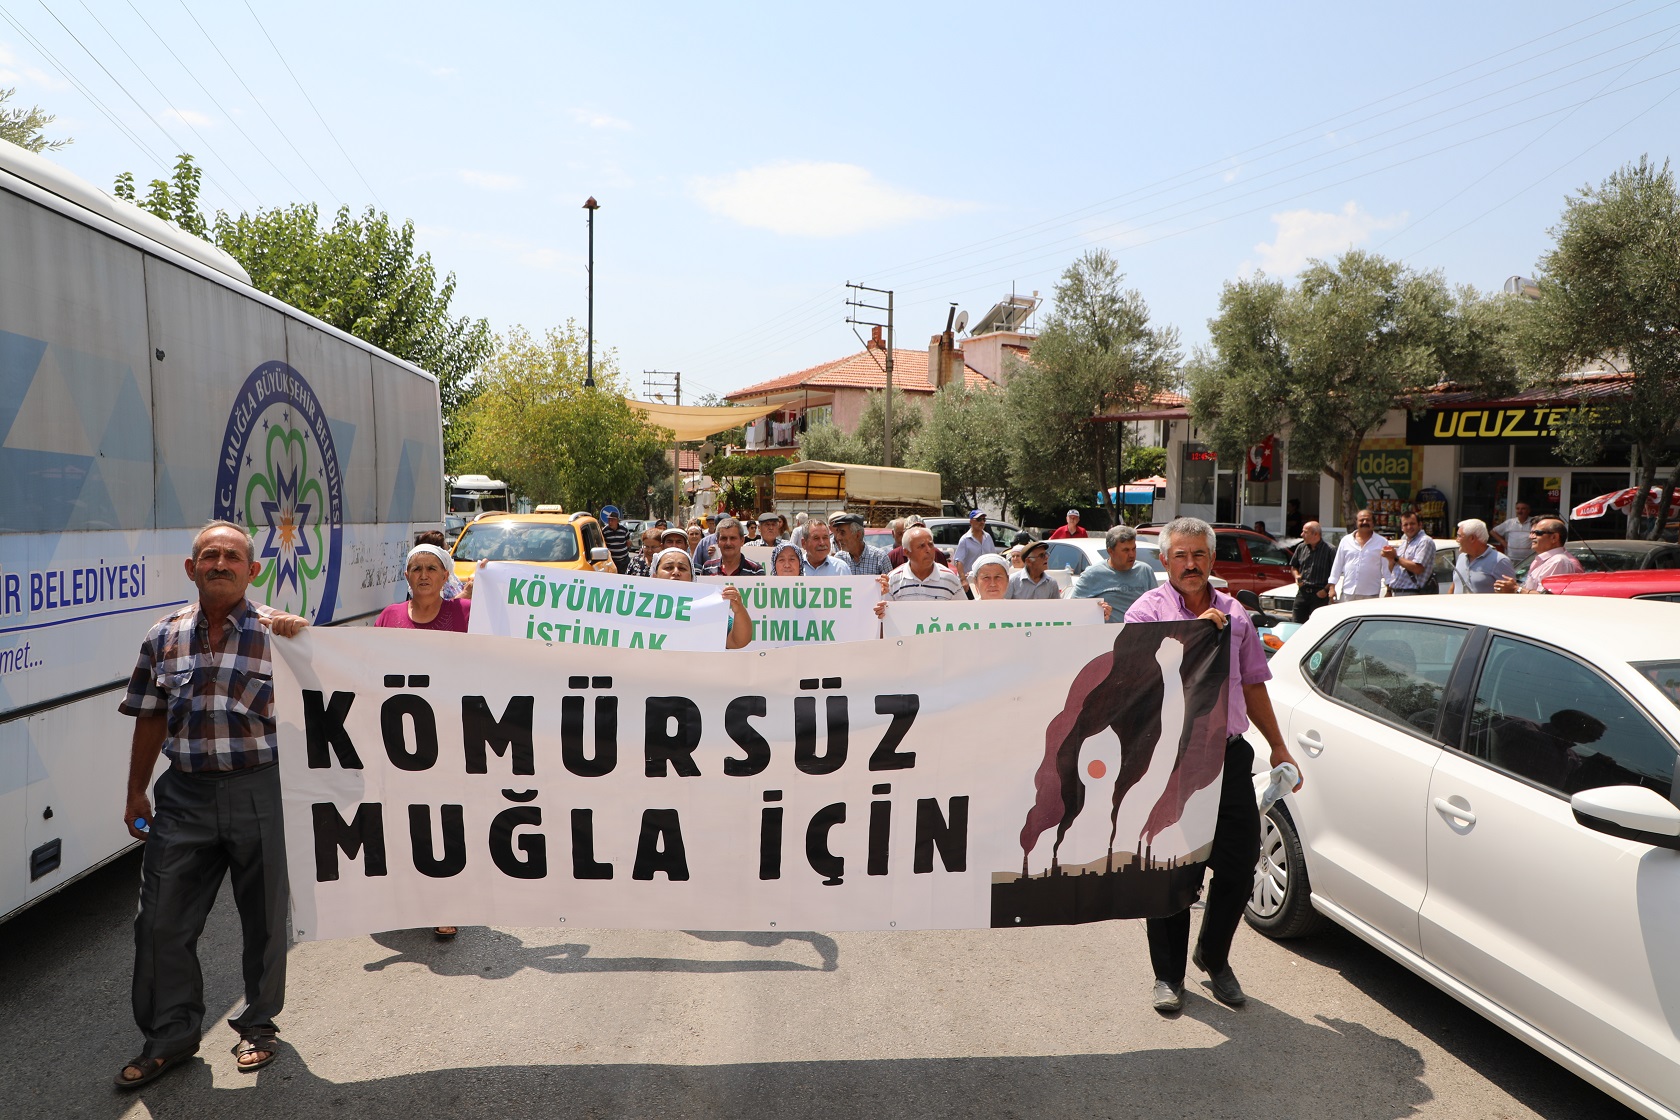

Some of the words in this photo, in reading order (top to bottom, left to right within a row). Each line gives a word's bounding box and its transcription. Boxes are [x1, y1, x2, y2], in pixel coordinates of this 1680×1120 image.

[225, 391, 258, 475] MUĞLA
[255, 367, 317, 421] BÜYÜKŞEHİR
[1433, 409, 1539, 438] UCUZ
[1356, 453, 1410, 474] iddaa
[1547, 489, 1560, 497] +18
[30, 555, 146, 612] BELEDİYESİ
[507, 574, 694, 622] KÖYÜMÜZDE
[724, 582, 853, 609] YÜMÜZDE
[751, 614, 836, 641] TİMLAK
[302, 675, 919, 777] KÖMÜRSÜZ
[312, 789, 689, 882] MUĞLA
[760, 784, 969, 886] İÇİN
